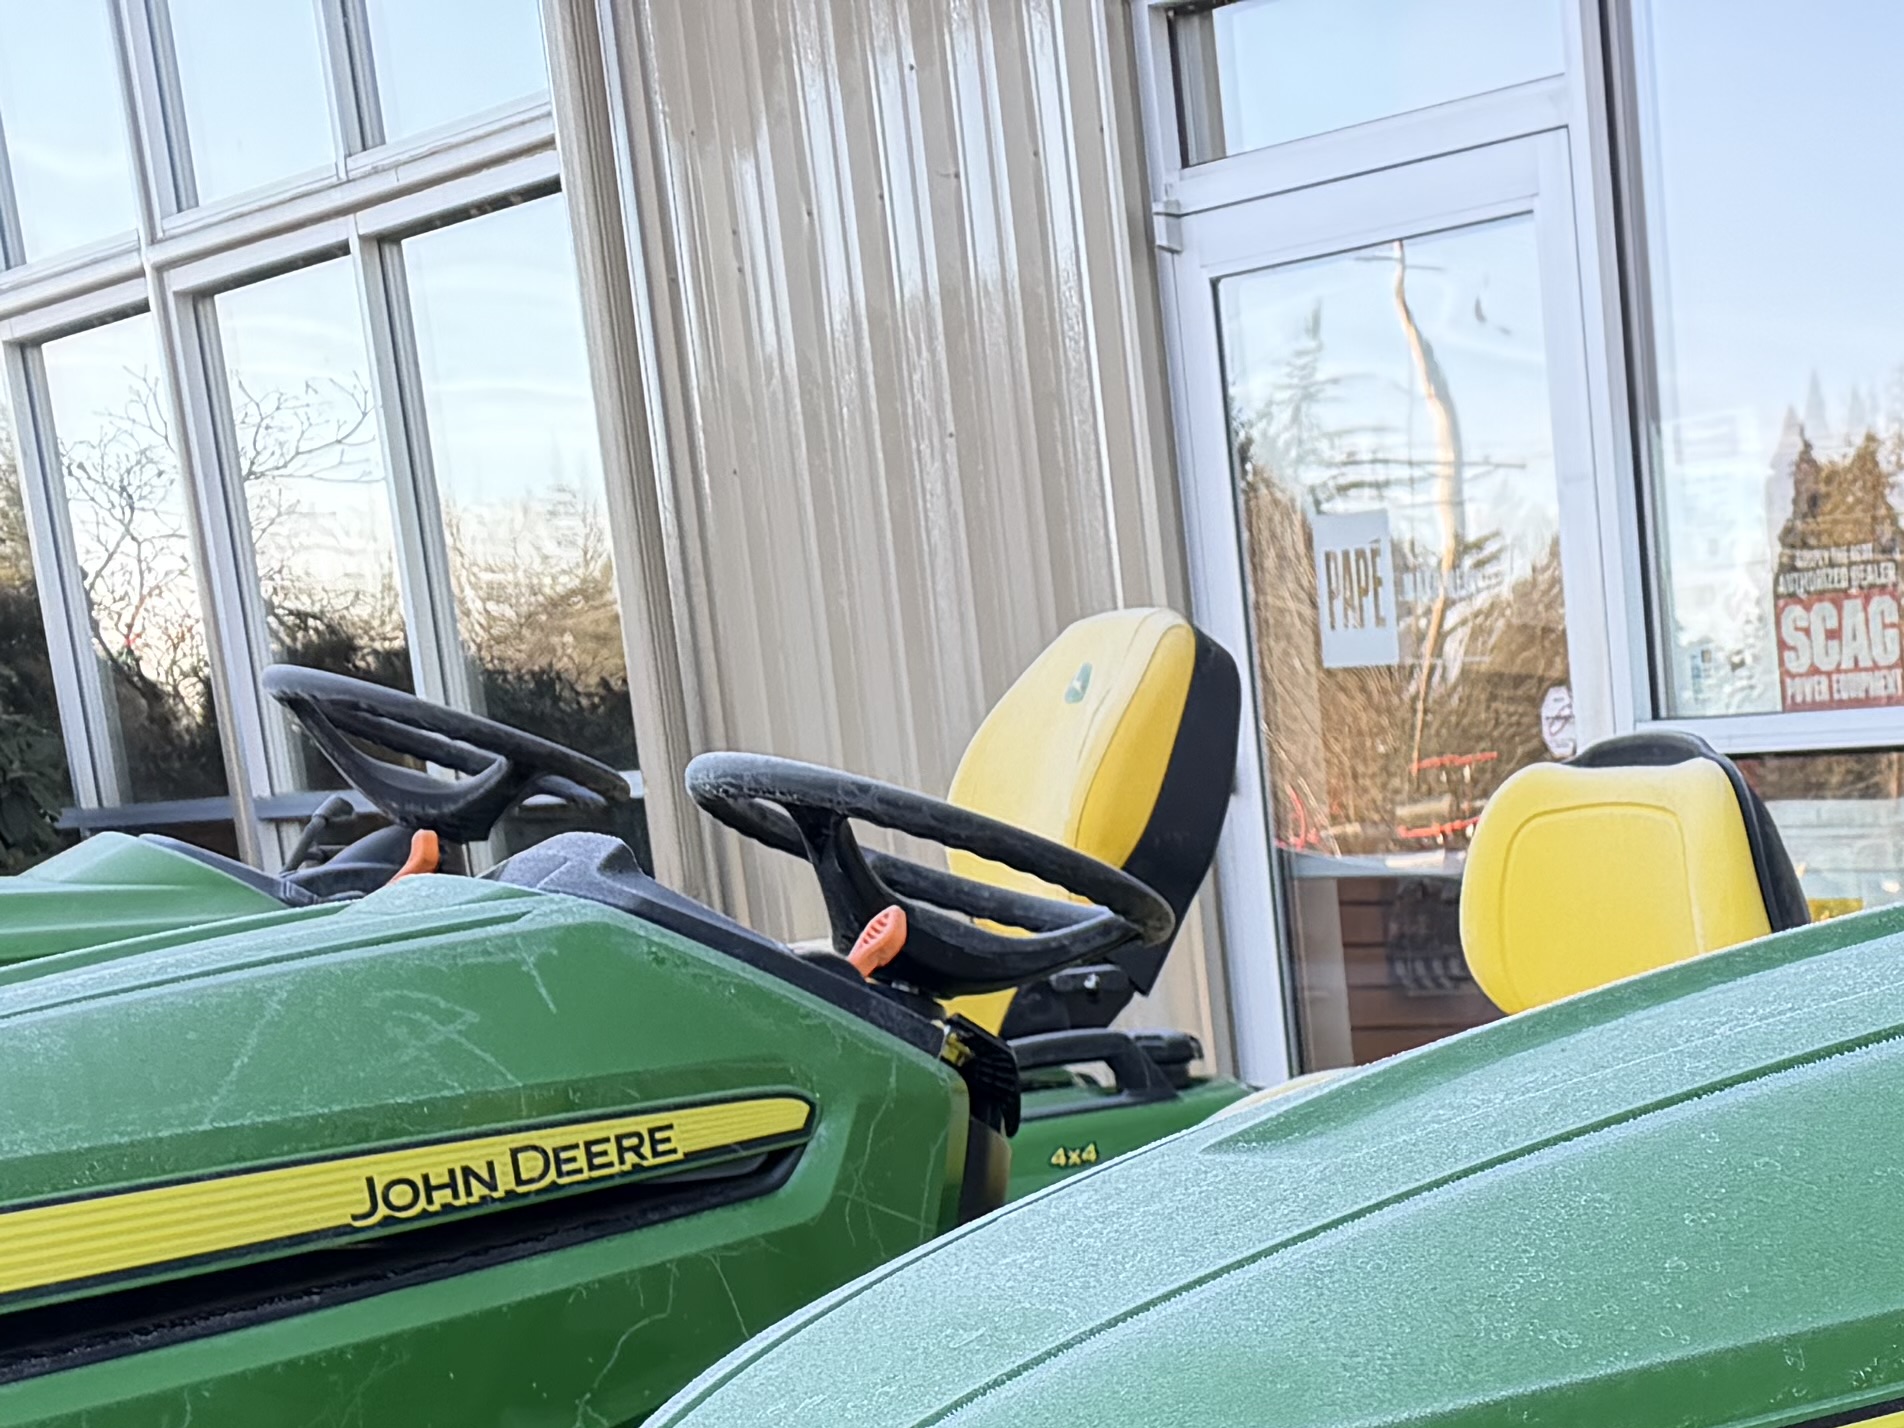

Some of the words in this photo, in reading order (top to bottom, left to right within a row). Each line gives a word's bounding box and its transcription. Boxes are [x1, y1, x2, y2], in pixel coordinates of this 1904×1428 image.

[1324, 538, 1386, 632] PAPÉ
[1778, 565, 1849, 595] AUTHORIZED
[1850, 560, 1897, 589] DEALER
[1780, 594, 1901, 676] SCAG
[1784, 674, 1830, 704] POWER
[1832, 668, 1903, 701] EQUIPMENT
[350, 1159, 500, 1223] JOHN
[508, 1123, 678, 1188] DEERE
[1049, 1141, 1098, 1169] 4x4
